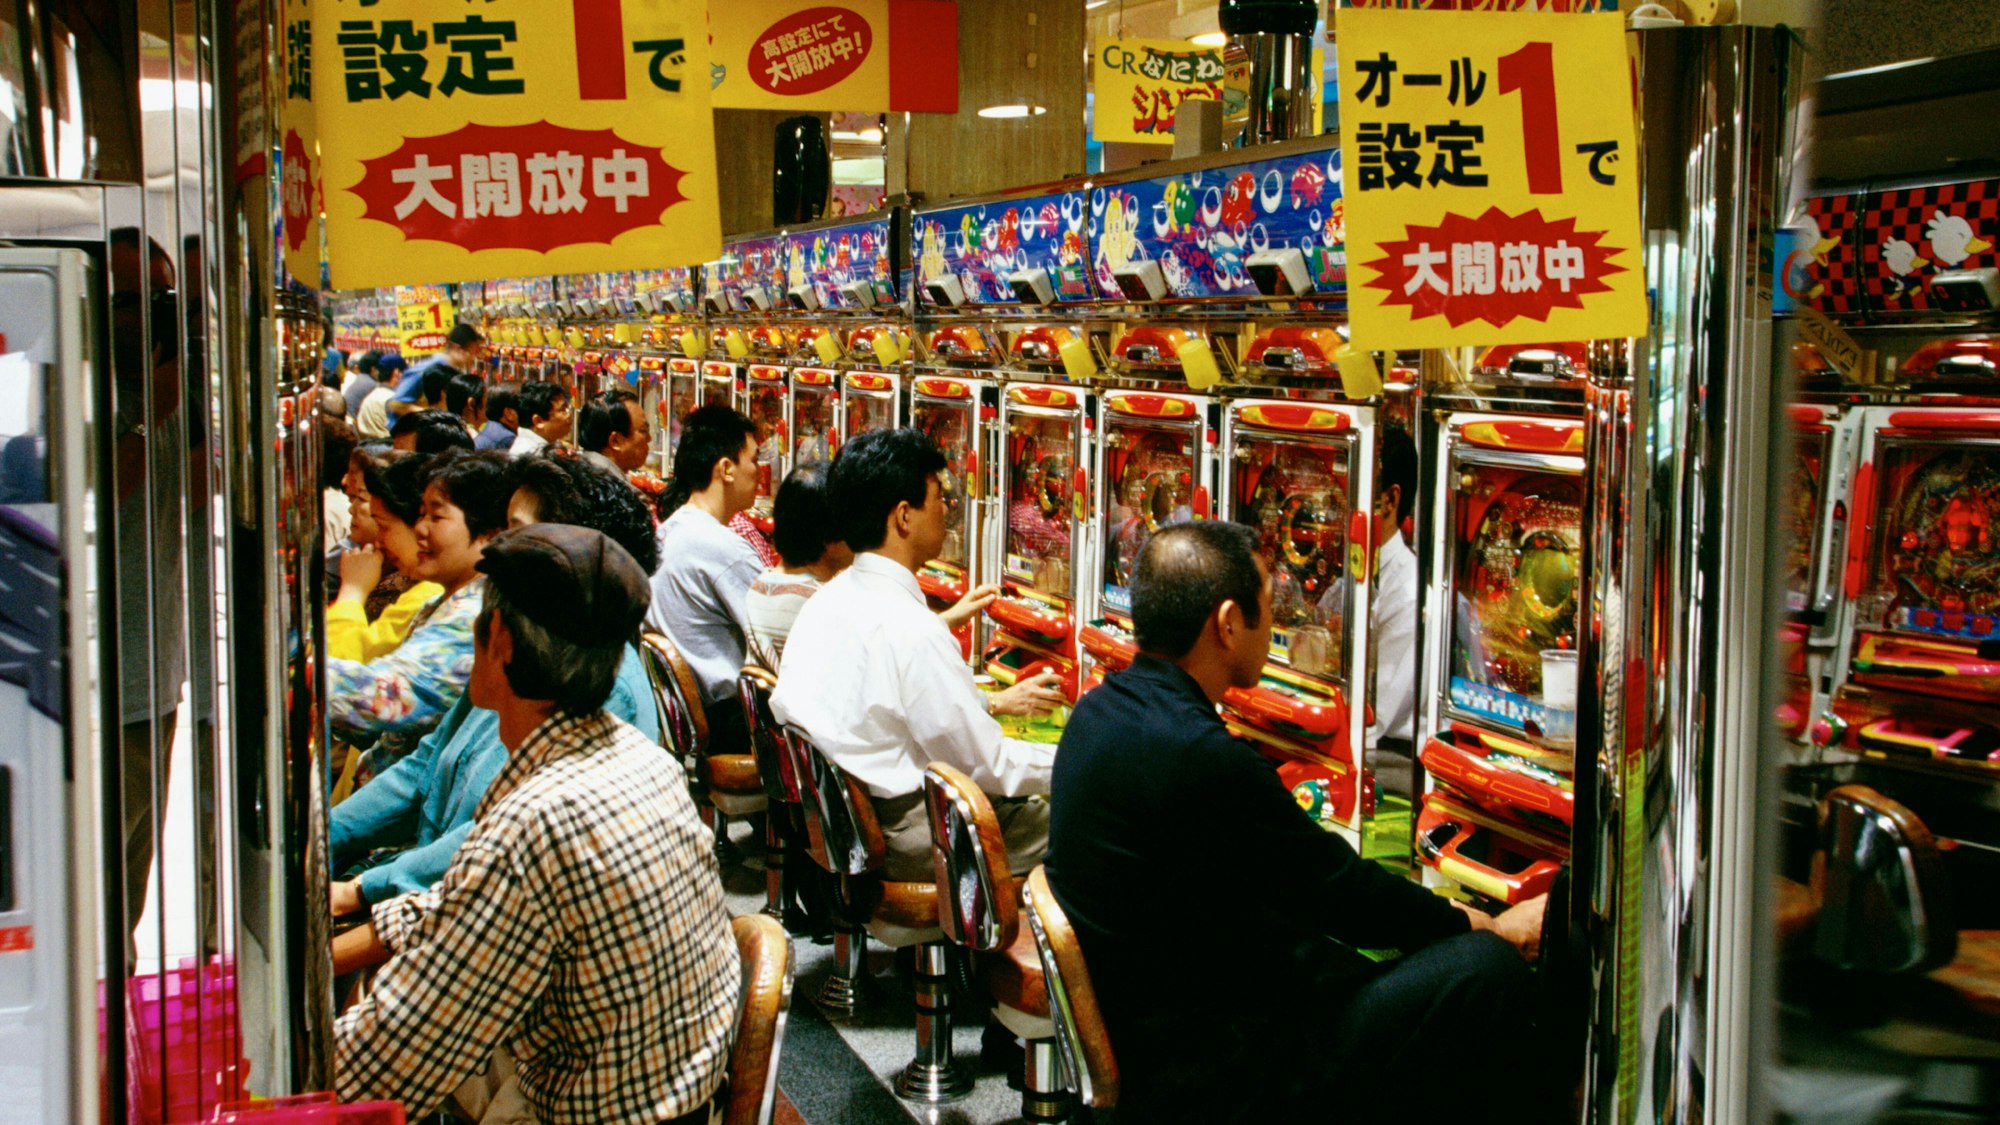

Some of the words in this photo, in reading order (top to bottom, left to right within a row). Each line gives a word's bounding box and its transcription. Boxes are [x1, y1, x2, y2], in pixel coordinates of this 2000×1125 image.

[337, 15, 525, 103] 設定
[632, 38, 687, 93] で
[761, 14, 847, 60] 高設定にて
[1103, 45, 1138, 75] CR
[1355, 52, 1487, 107] オール
[1356, 120, 1488, 191] 設定
[1497, 41, 1563, 195] 1
[1576, 140, 1620, 186] で
[391, 148, 649, 220] 大開放中
[1402, 239, 1585, 297] 大開放中
[428, 304, 442, 329] 1
